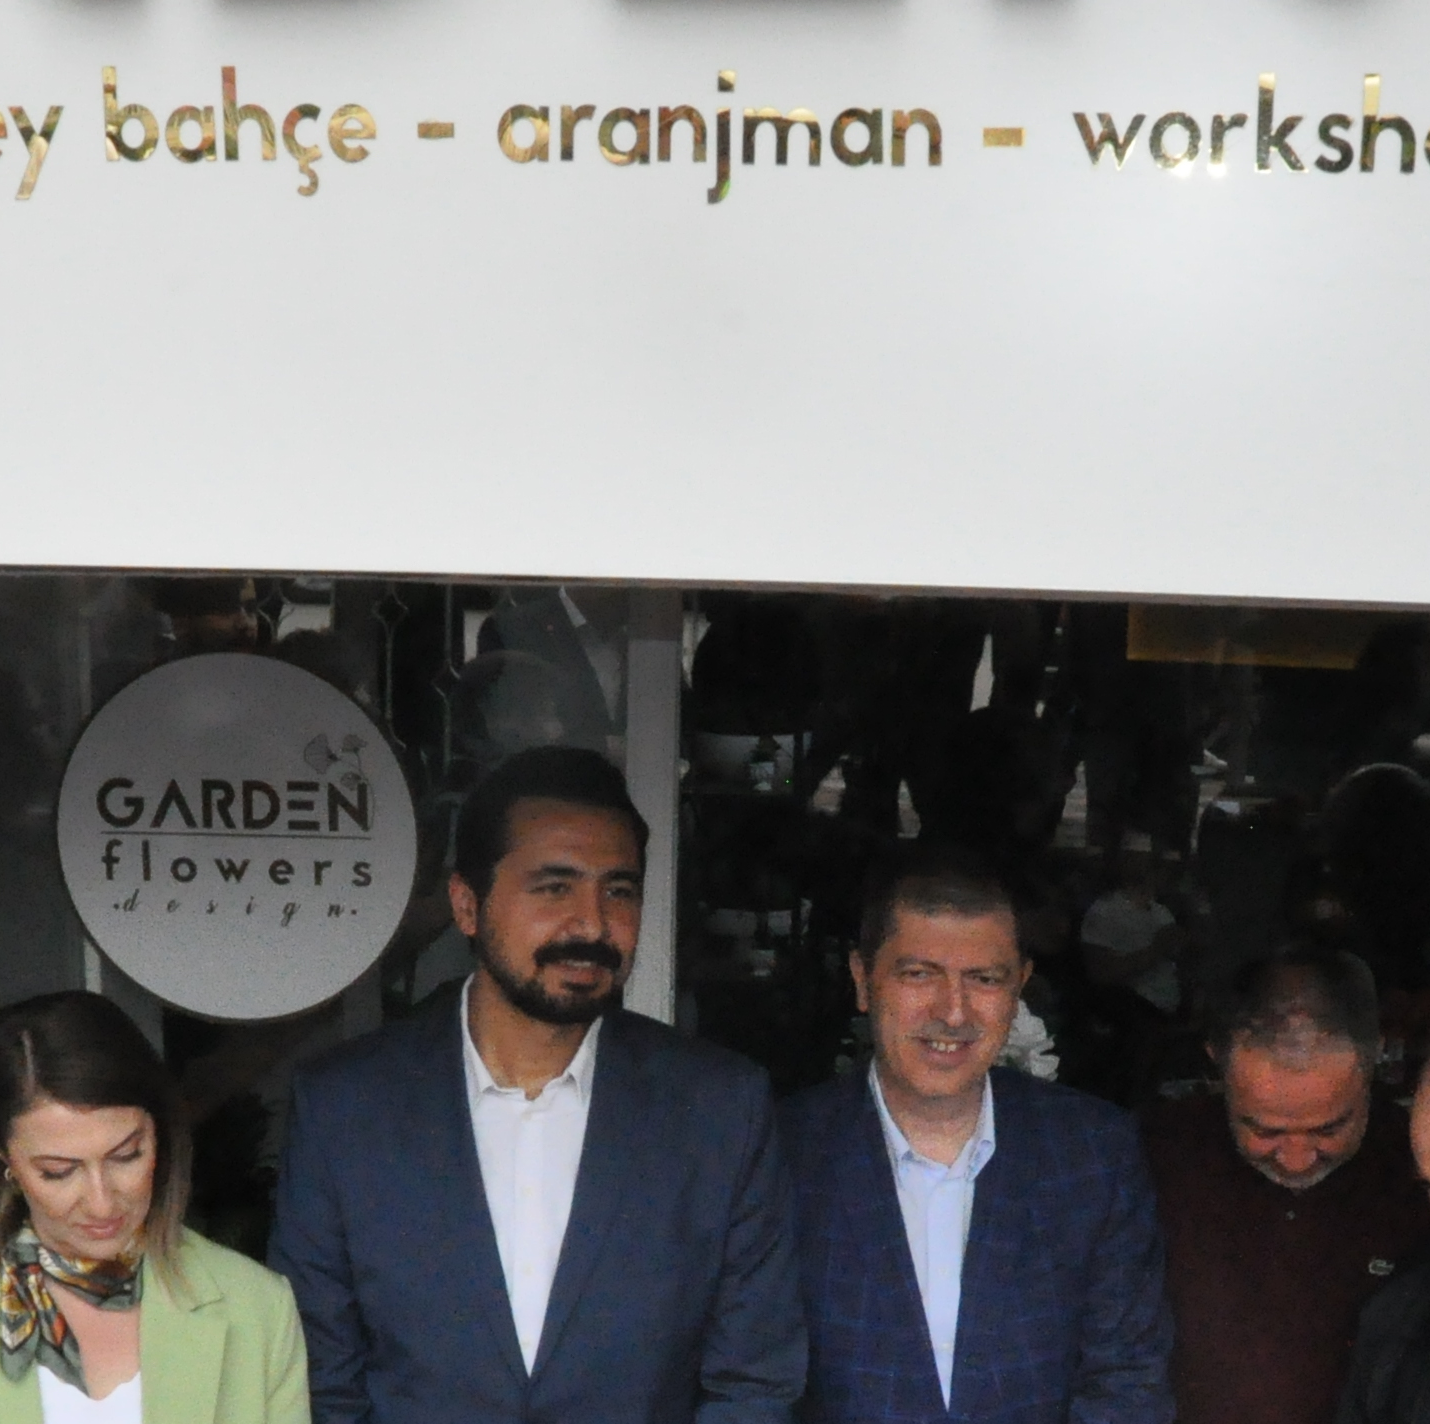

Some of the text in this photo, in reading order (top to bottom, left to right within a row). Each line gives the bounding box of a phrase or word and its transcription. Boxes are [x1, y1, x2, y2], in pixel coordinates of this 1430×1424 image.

[101, 65, 378, 198] bahçe
[496, 69, 944, 206] aranjman
[96, 776, 369, 832] GARDEN
[101, 838, 372, 887] flowers
